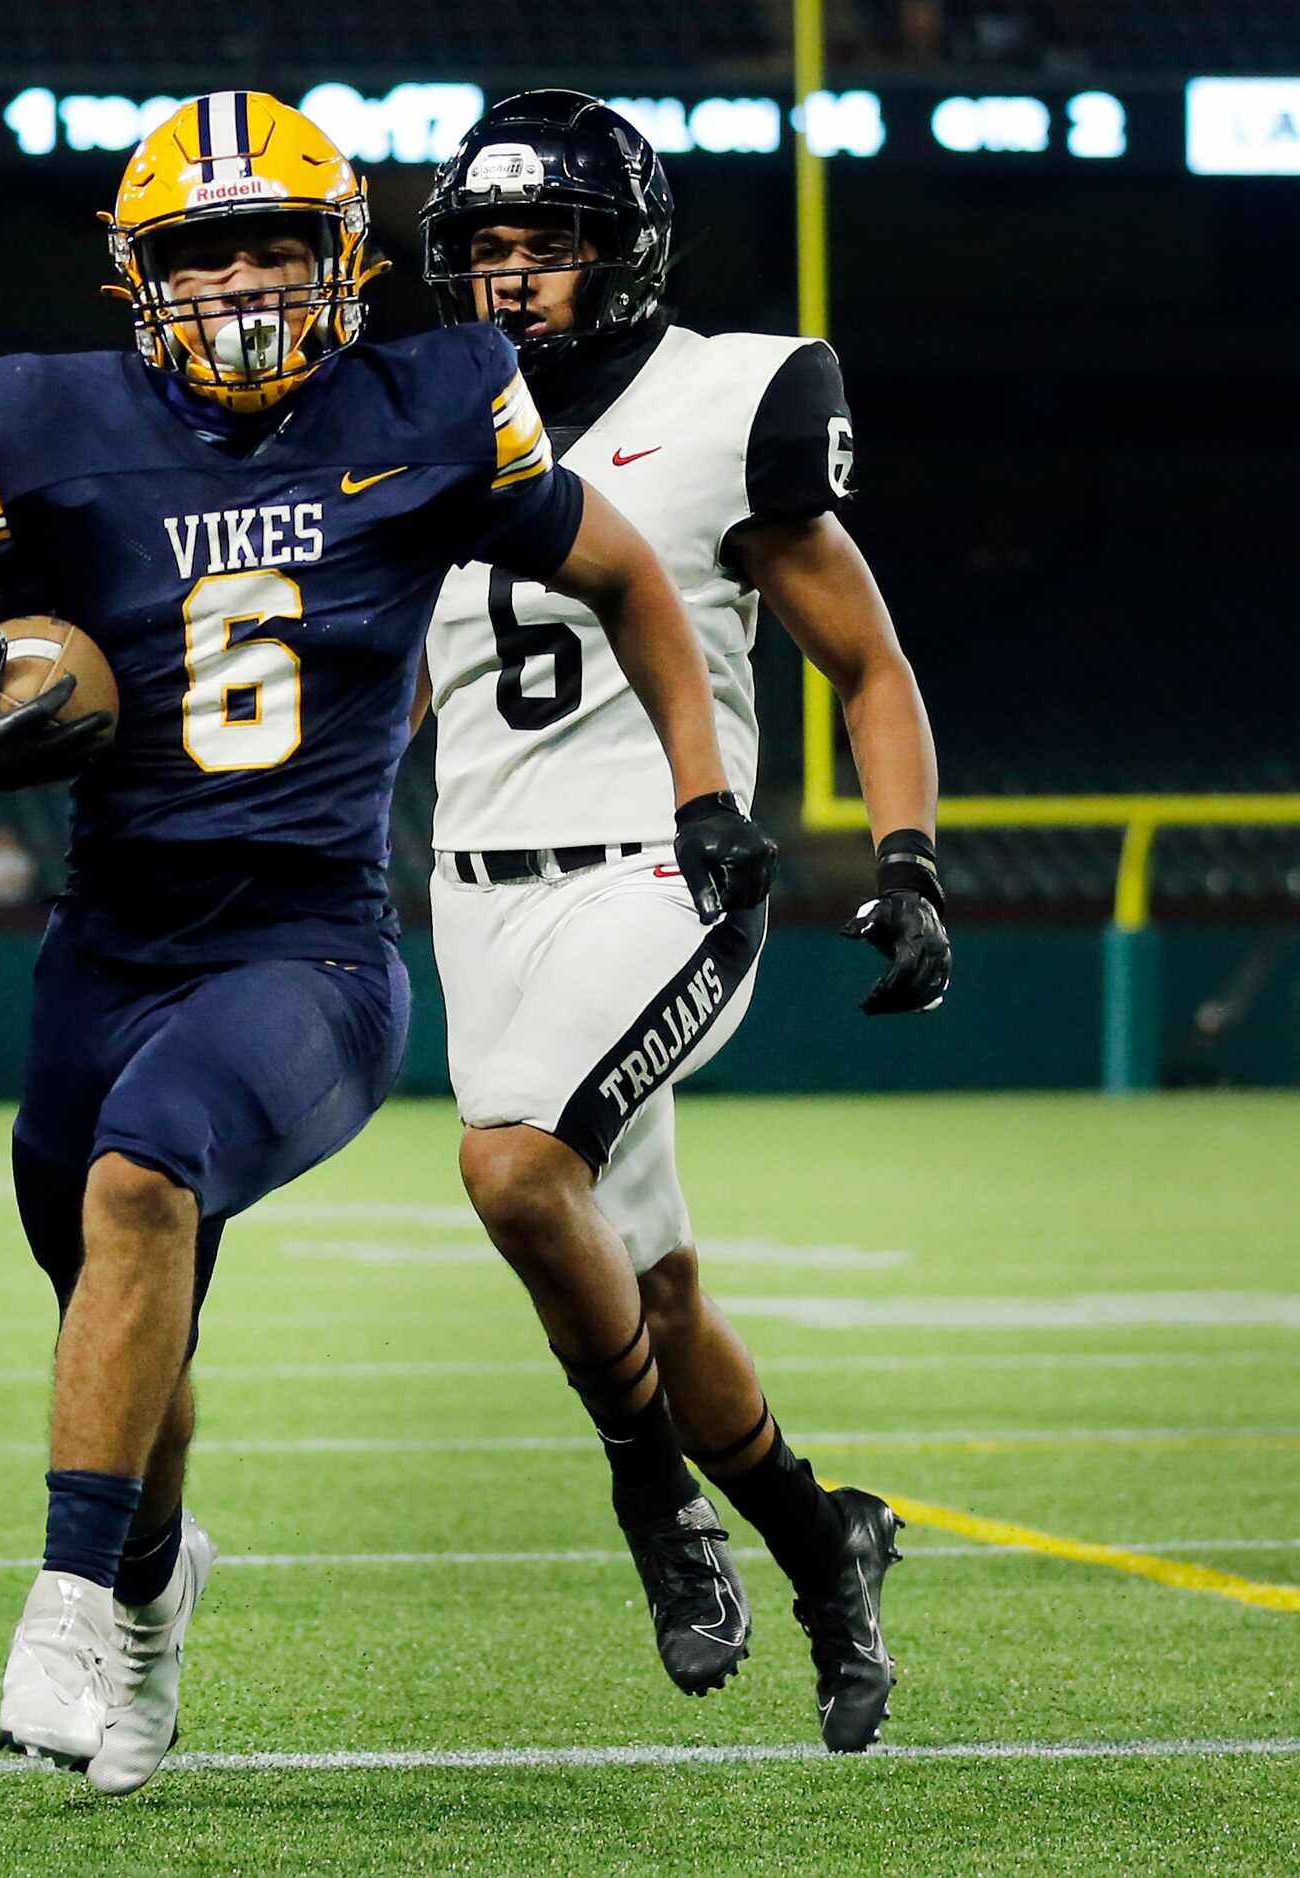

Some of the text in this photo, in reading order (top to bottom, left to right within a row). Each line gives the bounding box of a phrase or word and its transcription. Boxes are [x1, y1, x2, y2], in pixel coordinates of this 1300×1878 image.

[196, 180, 262, 202] Riddell
[163, 502, 324, 580] VIKES
[182, 567, 304, 773] 6
[487, 562, 583, 731] 6
[598, 956, 725, 1117] TROJANS
